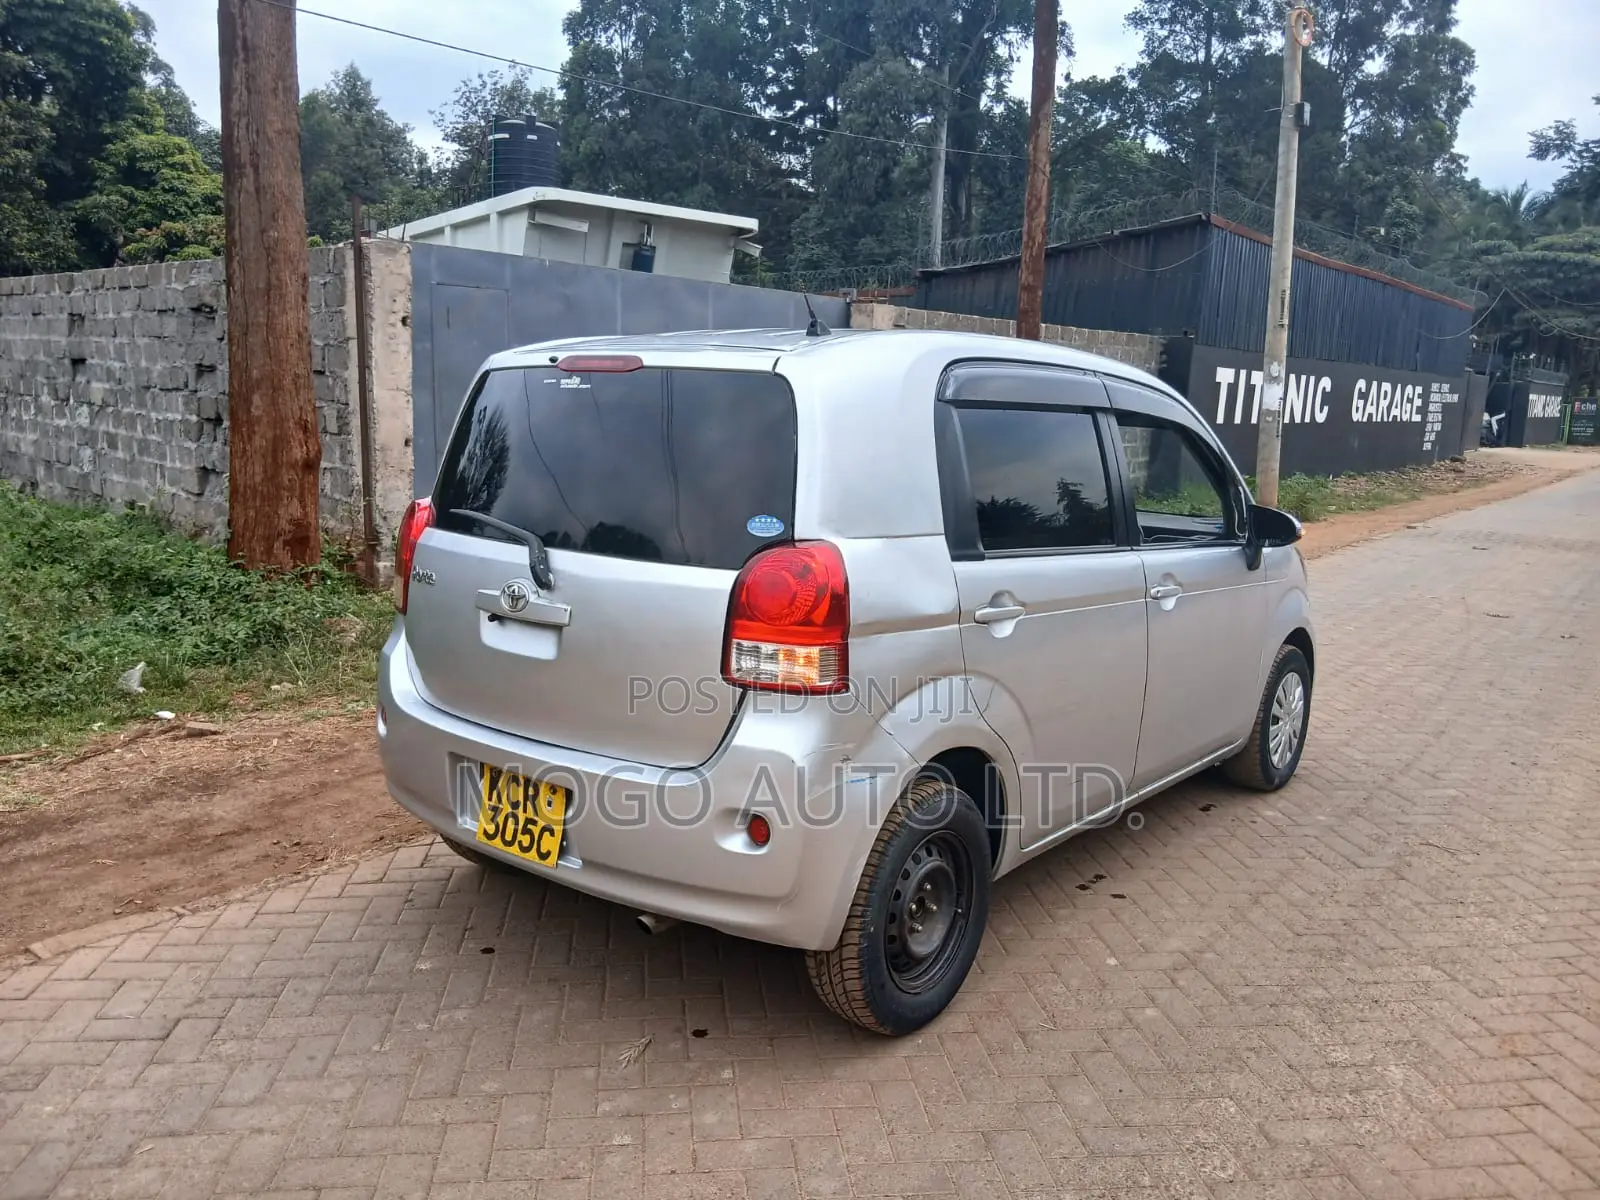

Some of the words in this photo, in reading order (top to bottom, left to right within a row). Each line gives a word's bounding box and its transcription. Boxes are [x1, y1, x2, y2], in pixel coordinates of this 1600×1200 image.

[1215, 366, 1332, 424] TITNIC
[1351, 378, 1423, 423] GARAGE
[487, 766, 540, 817] KCR
[483, 803, 556, 861] 305C
